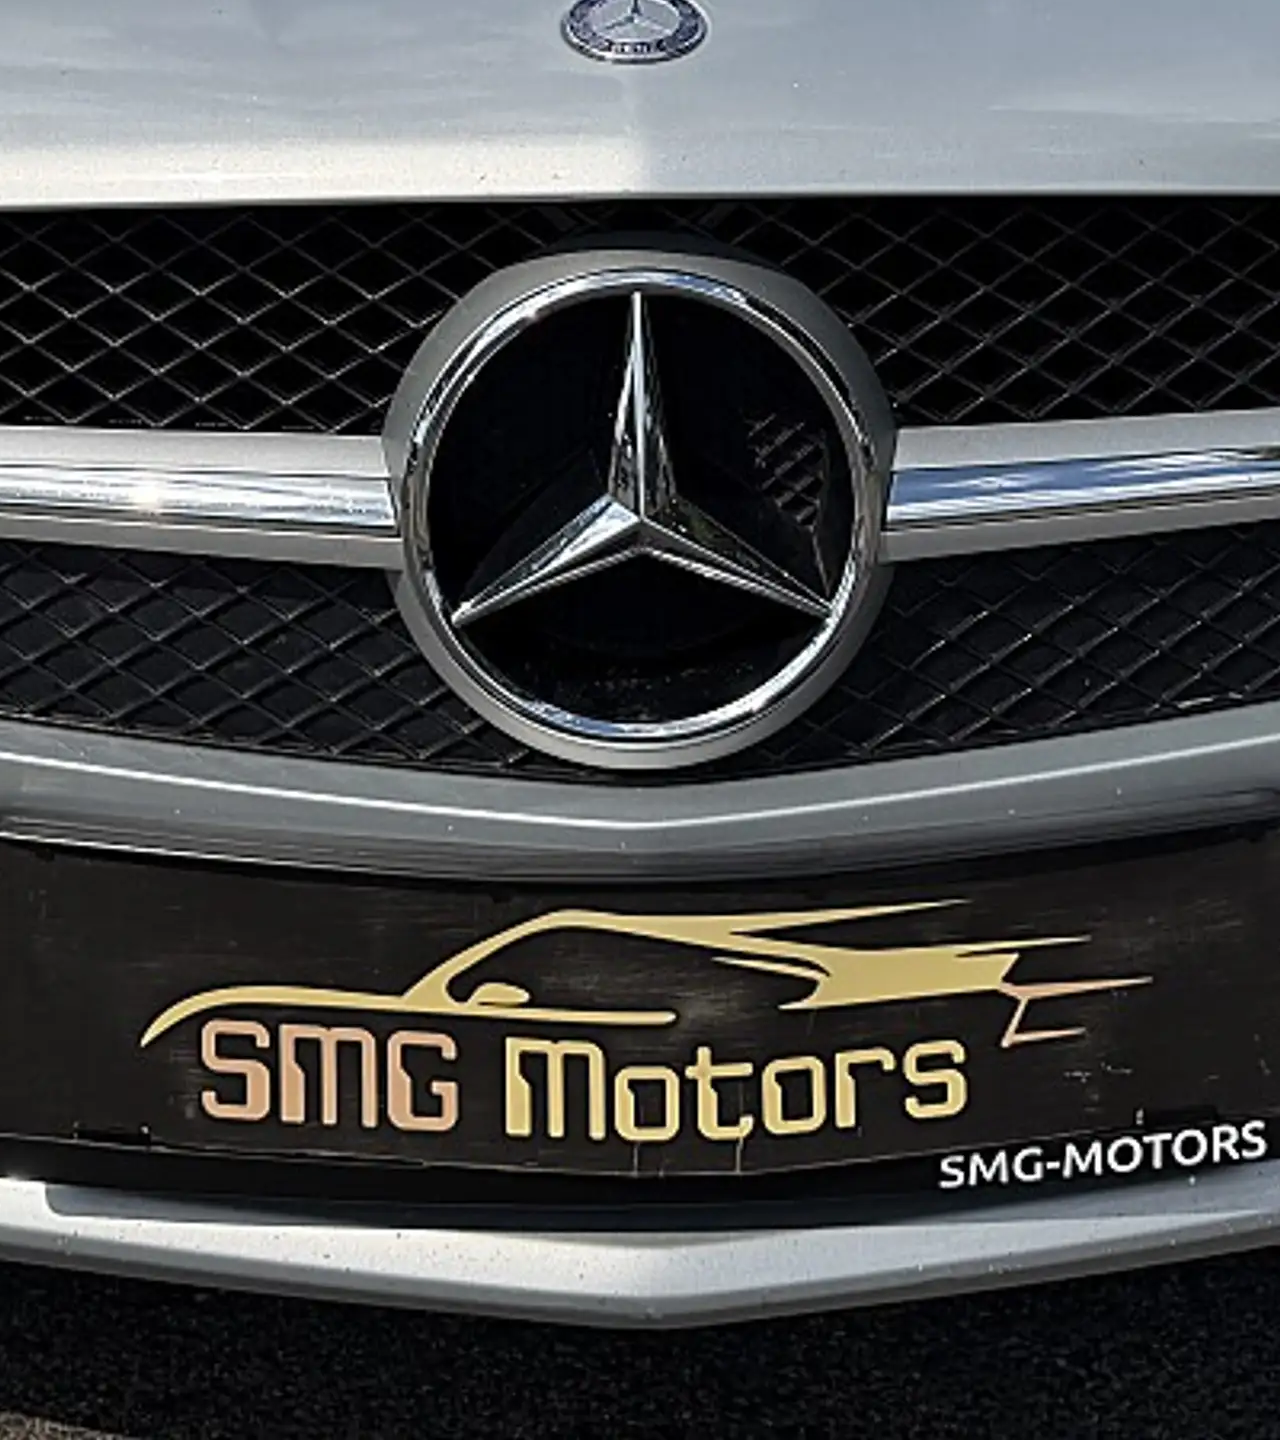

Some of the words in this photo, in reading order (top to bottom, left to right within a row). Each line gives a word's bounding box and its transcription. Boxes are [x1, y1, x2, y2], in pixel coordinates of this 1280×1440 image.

[200, 1018, 460, 1133] SMG
[503, 1035, 969, 1143] Motors
[938, 1119, 1268, 1190] SMG-MOTORS
